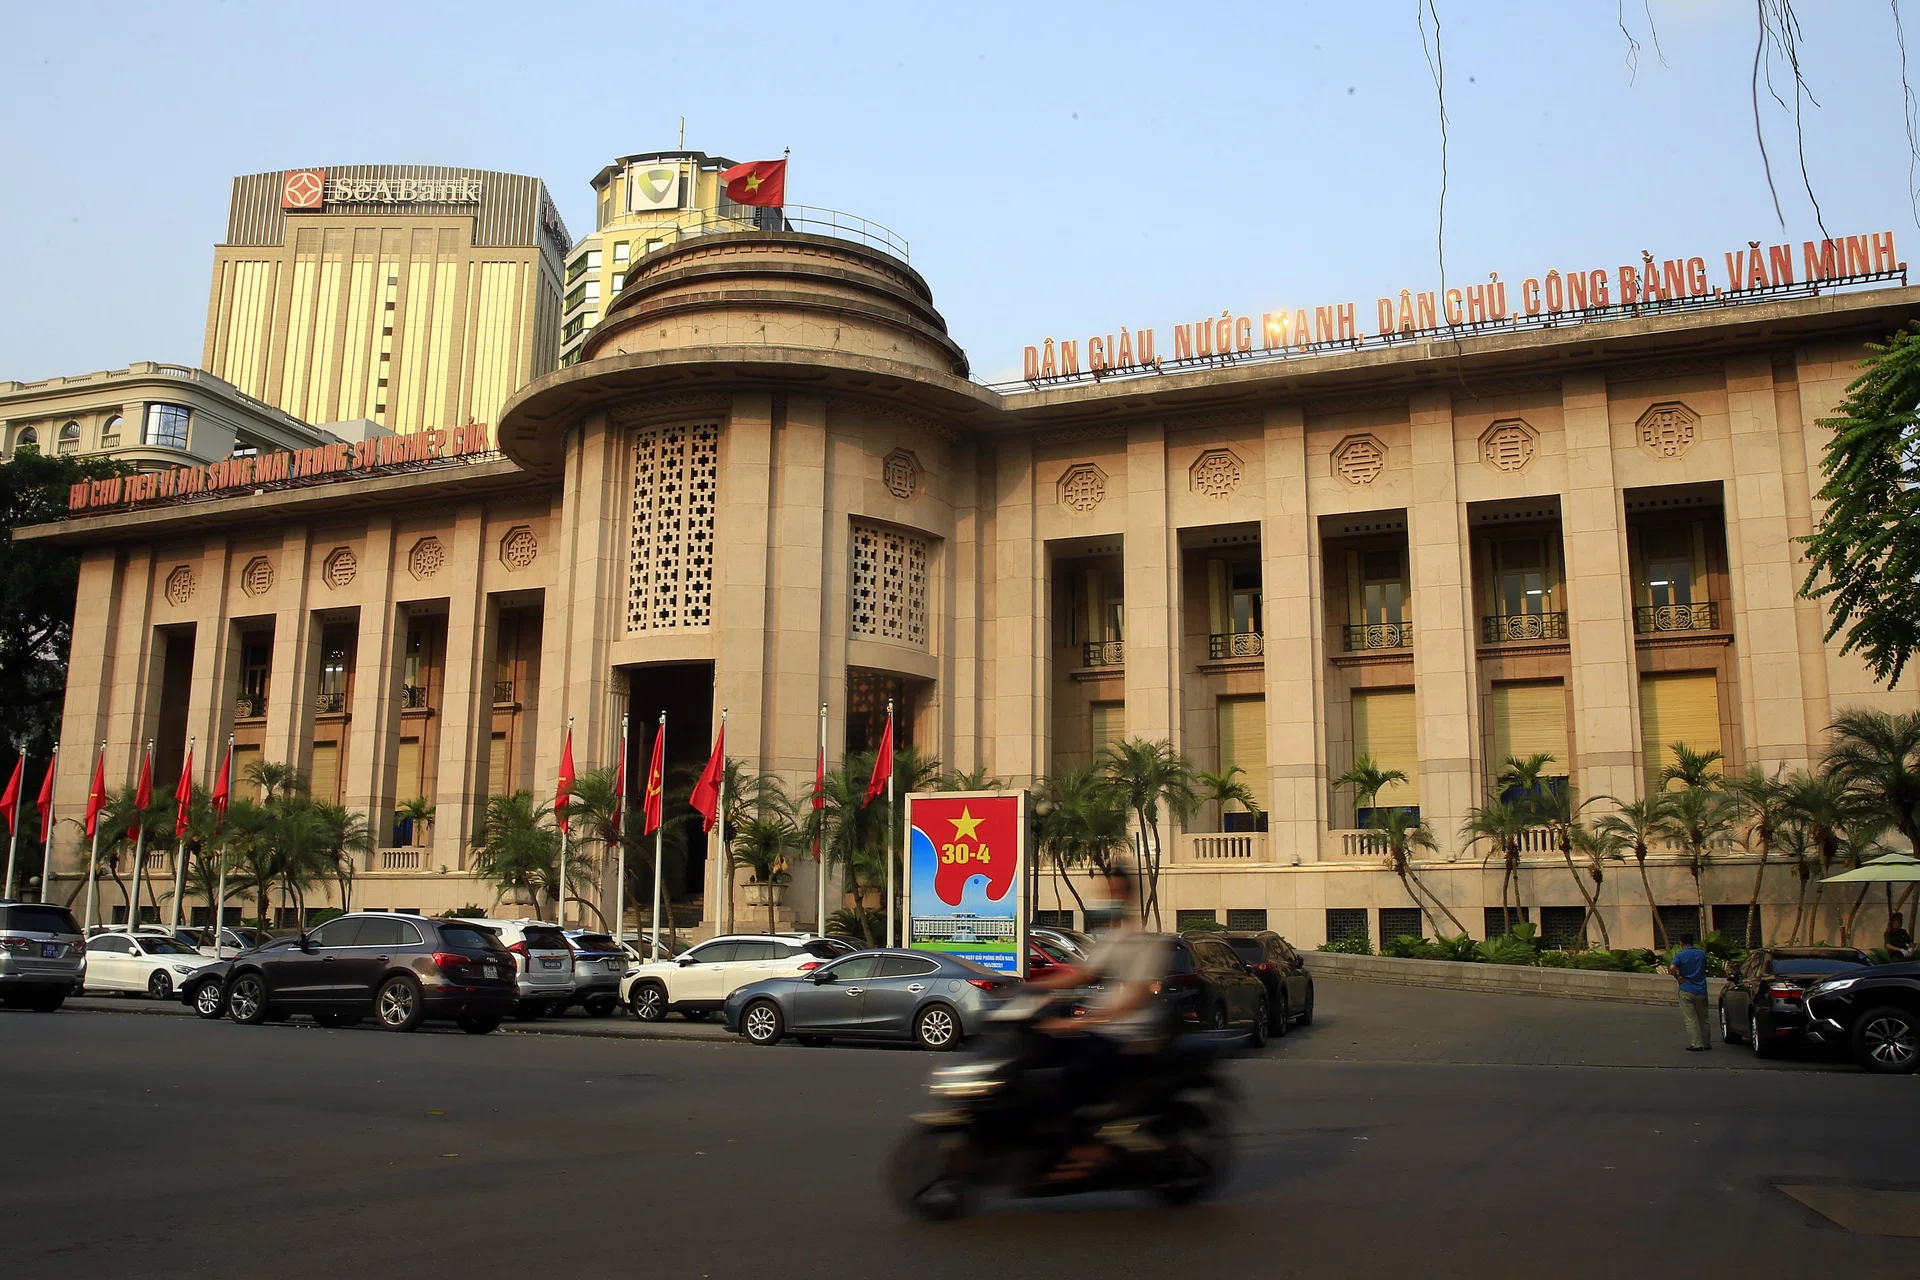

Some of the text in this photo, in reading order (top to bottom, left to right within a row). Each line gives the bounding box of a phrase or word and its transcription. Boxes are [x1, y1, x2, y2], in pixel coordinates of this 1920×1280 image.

[334, 176, 481, 202] SeABank
[1024, 336, 1079, 381] DÂN
[1088, 325, 1163, 371] GIÀU,
[1173, 309, 1252, 361] NƯỚC
[1377, 288, 1437, 335] DÂN
[1446, 271, 1518, 325] CHỦ,
[1522, 268, 1610, 315] CÔNG
[1725, 241, 1794, 291] VĂN
[90, 470, 122, 507] CHỦ
[124, 472, 158, 507] TỊCH
[177, 465, 205, 499] ĐẠI
[207, 453, 253, 491] SỐNG
[254, 448, 290, 483] MÃI
[294, 442, 347, 477] TRONG
[352, 435, 379, 472] SỰ
[379, 426, 447, 464] NGHIỆP
[451, 416, 488, 456] CỦA
[941, 843, 991, 864] 30-4
